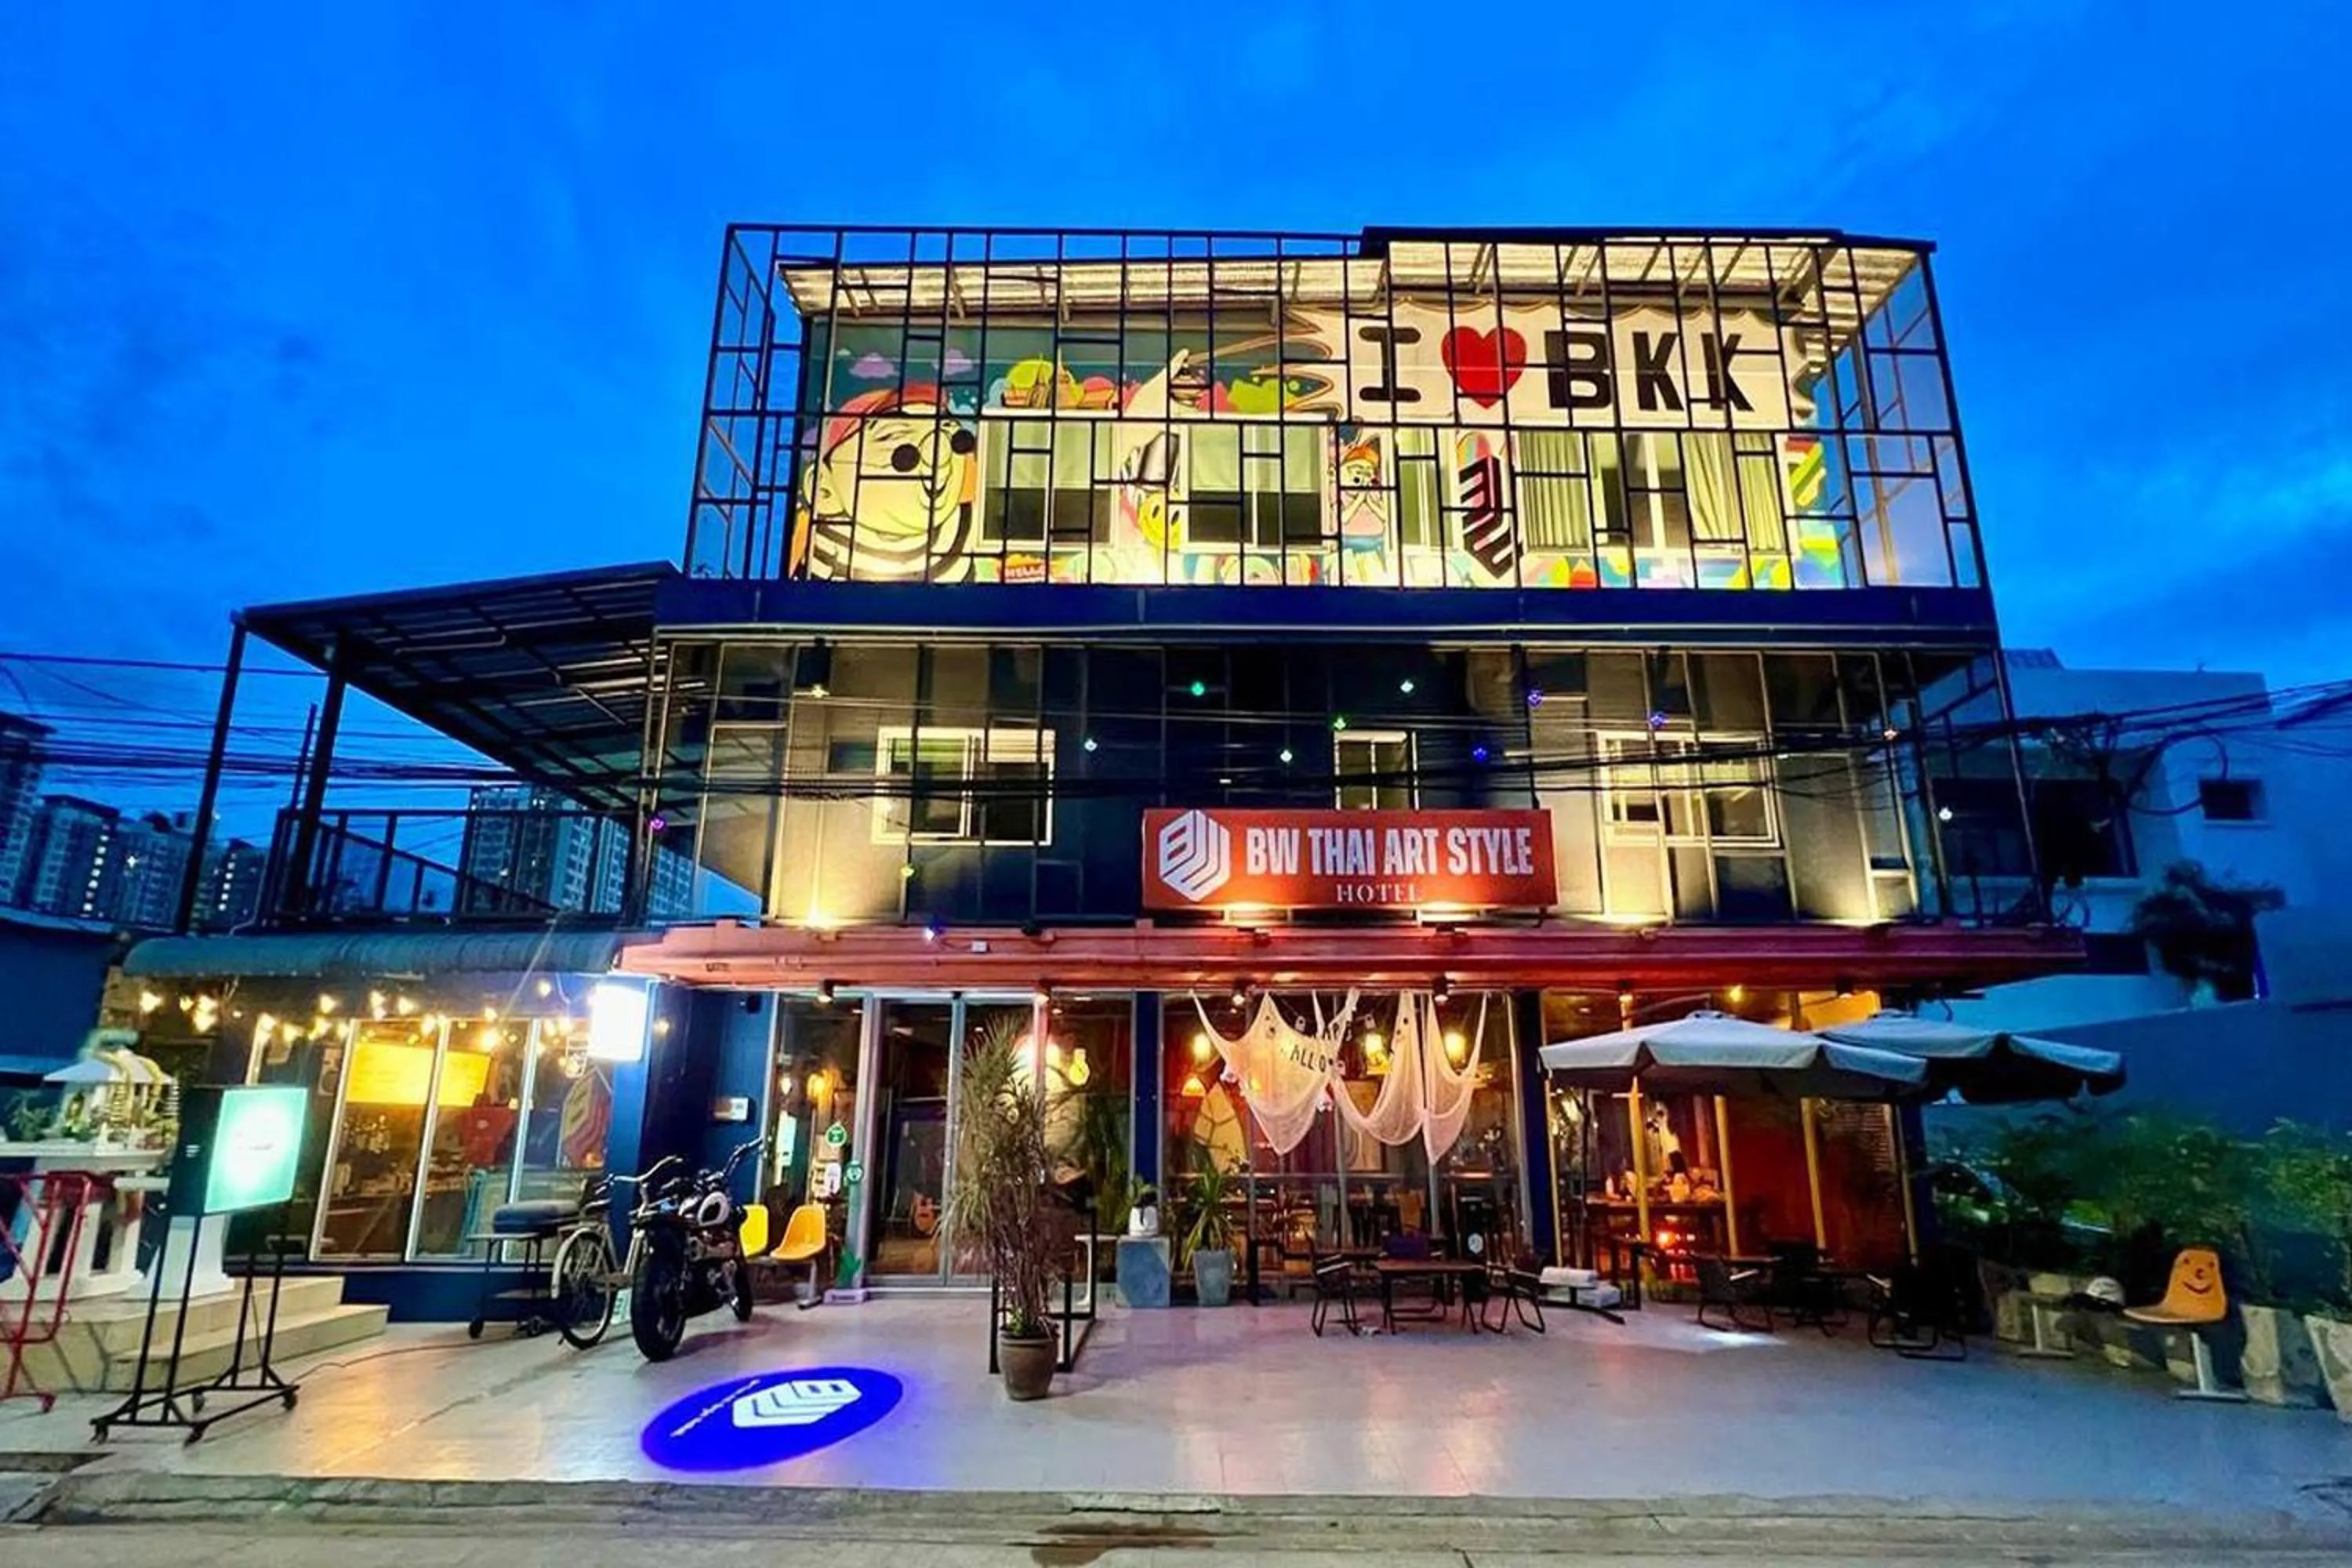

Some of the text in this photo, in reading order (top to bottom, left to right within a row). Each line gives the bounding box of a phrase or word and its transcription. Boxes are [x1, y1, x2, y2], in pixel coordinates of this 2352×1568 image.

[1359, 326, 1755, 412] I BKK
[1247, 828, 1534, 876] BW THAI ART STYLE
[1336, 881, 1423, 903] HOTEL
